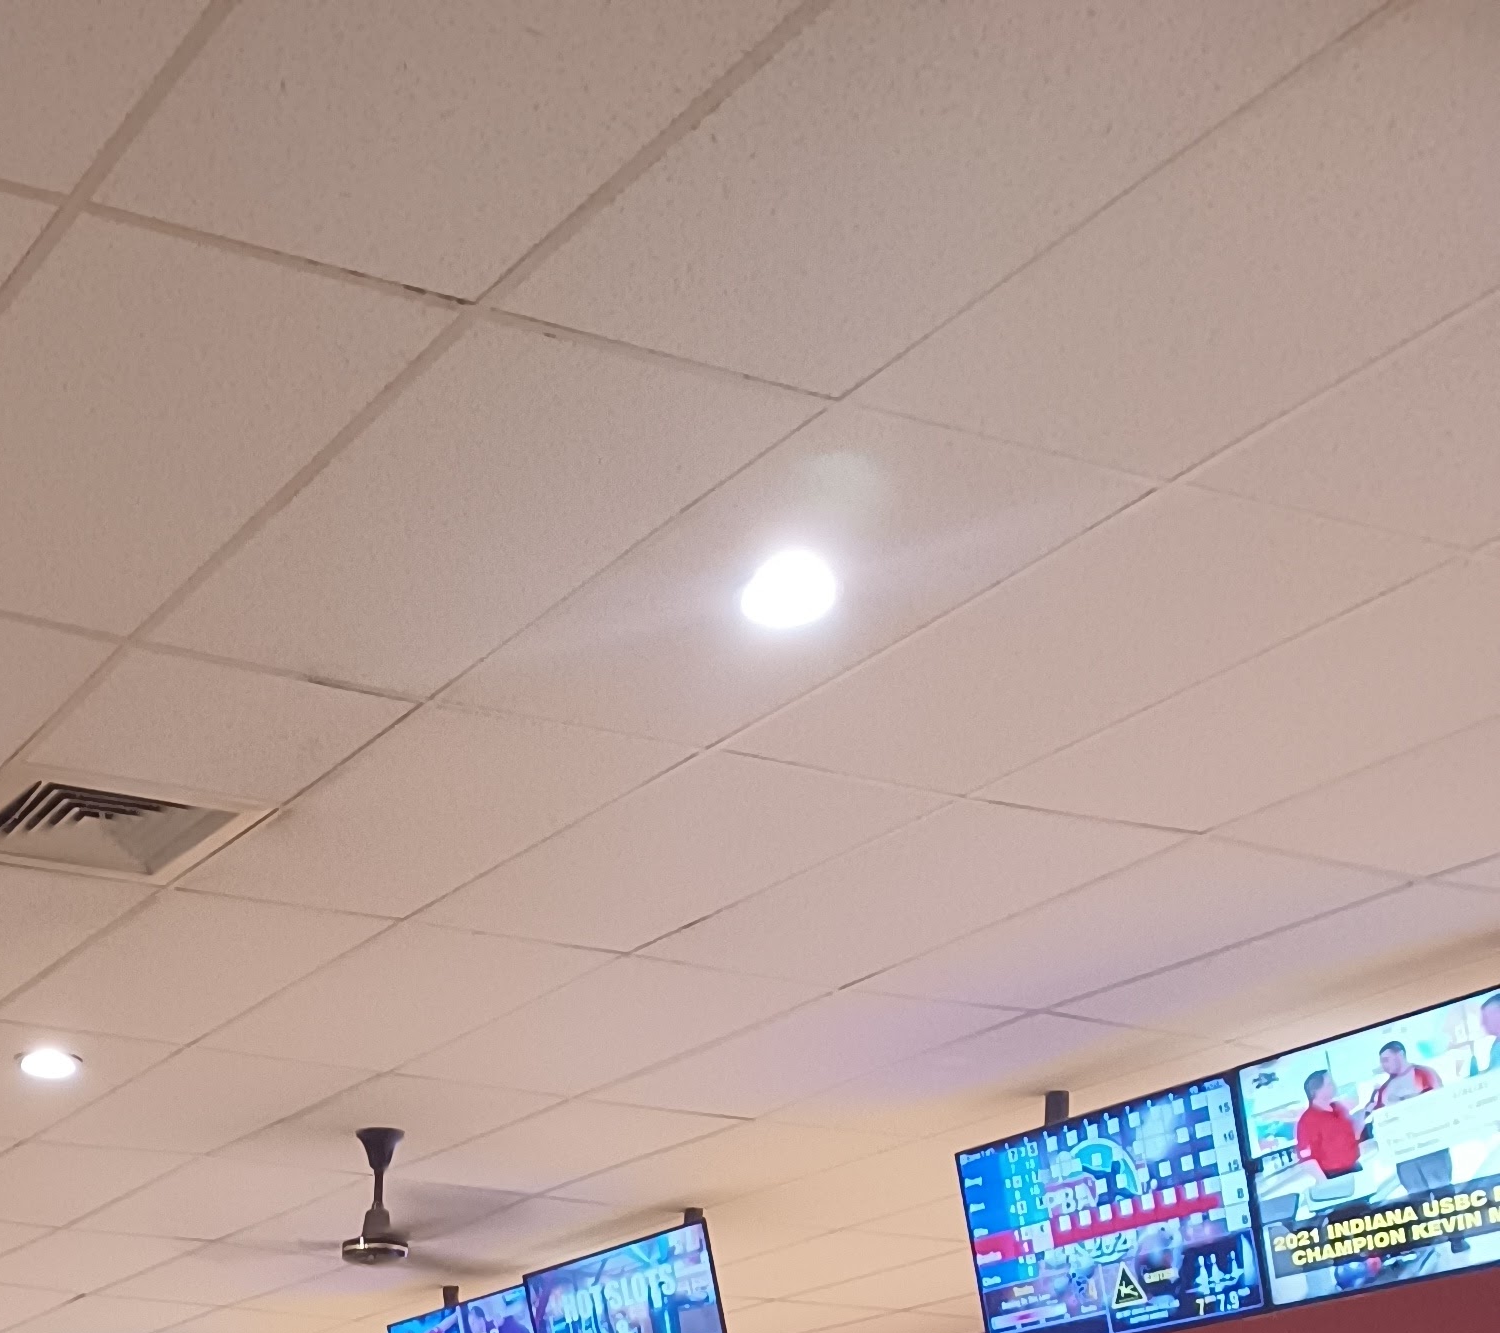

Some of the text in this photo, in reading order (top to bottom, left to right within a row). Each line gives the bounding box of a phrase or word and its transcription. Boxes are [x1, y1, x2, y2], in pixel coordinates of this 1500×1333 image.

[1273, 1227, 1320, 1252] 2021
[1327, 1205, 1418, 1240] INDIANA
[1422, 1189, 1488, 1218] USBC
[1292, 1229, 1406, 1267] CHAMPION
[1412, 1210, 1483, 1241] KEVIN
[561, 1284, 604, 1324] HOT
[604, 1263, 676, 1310] SLOTS
